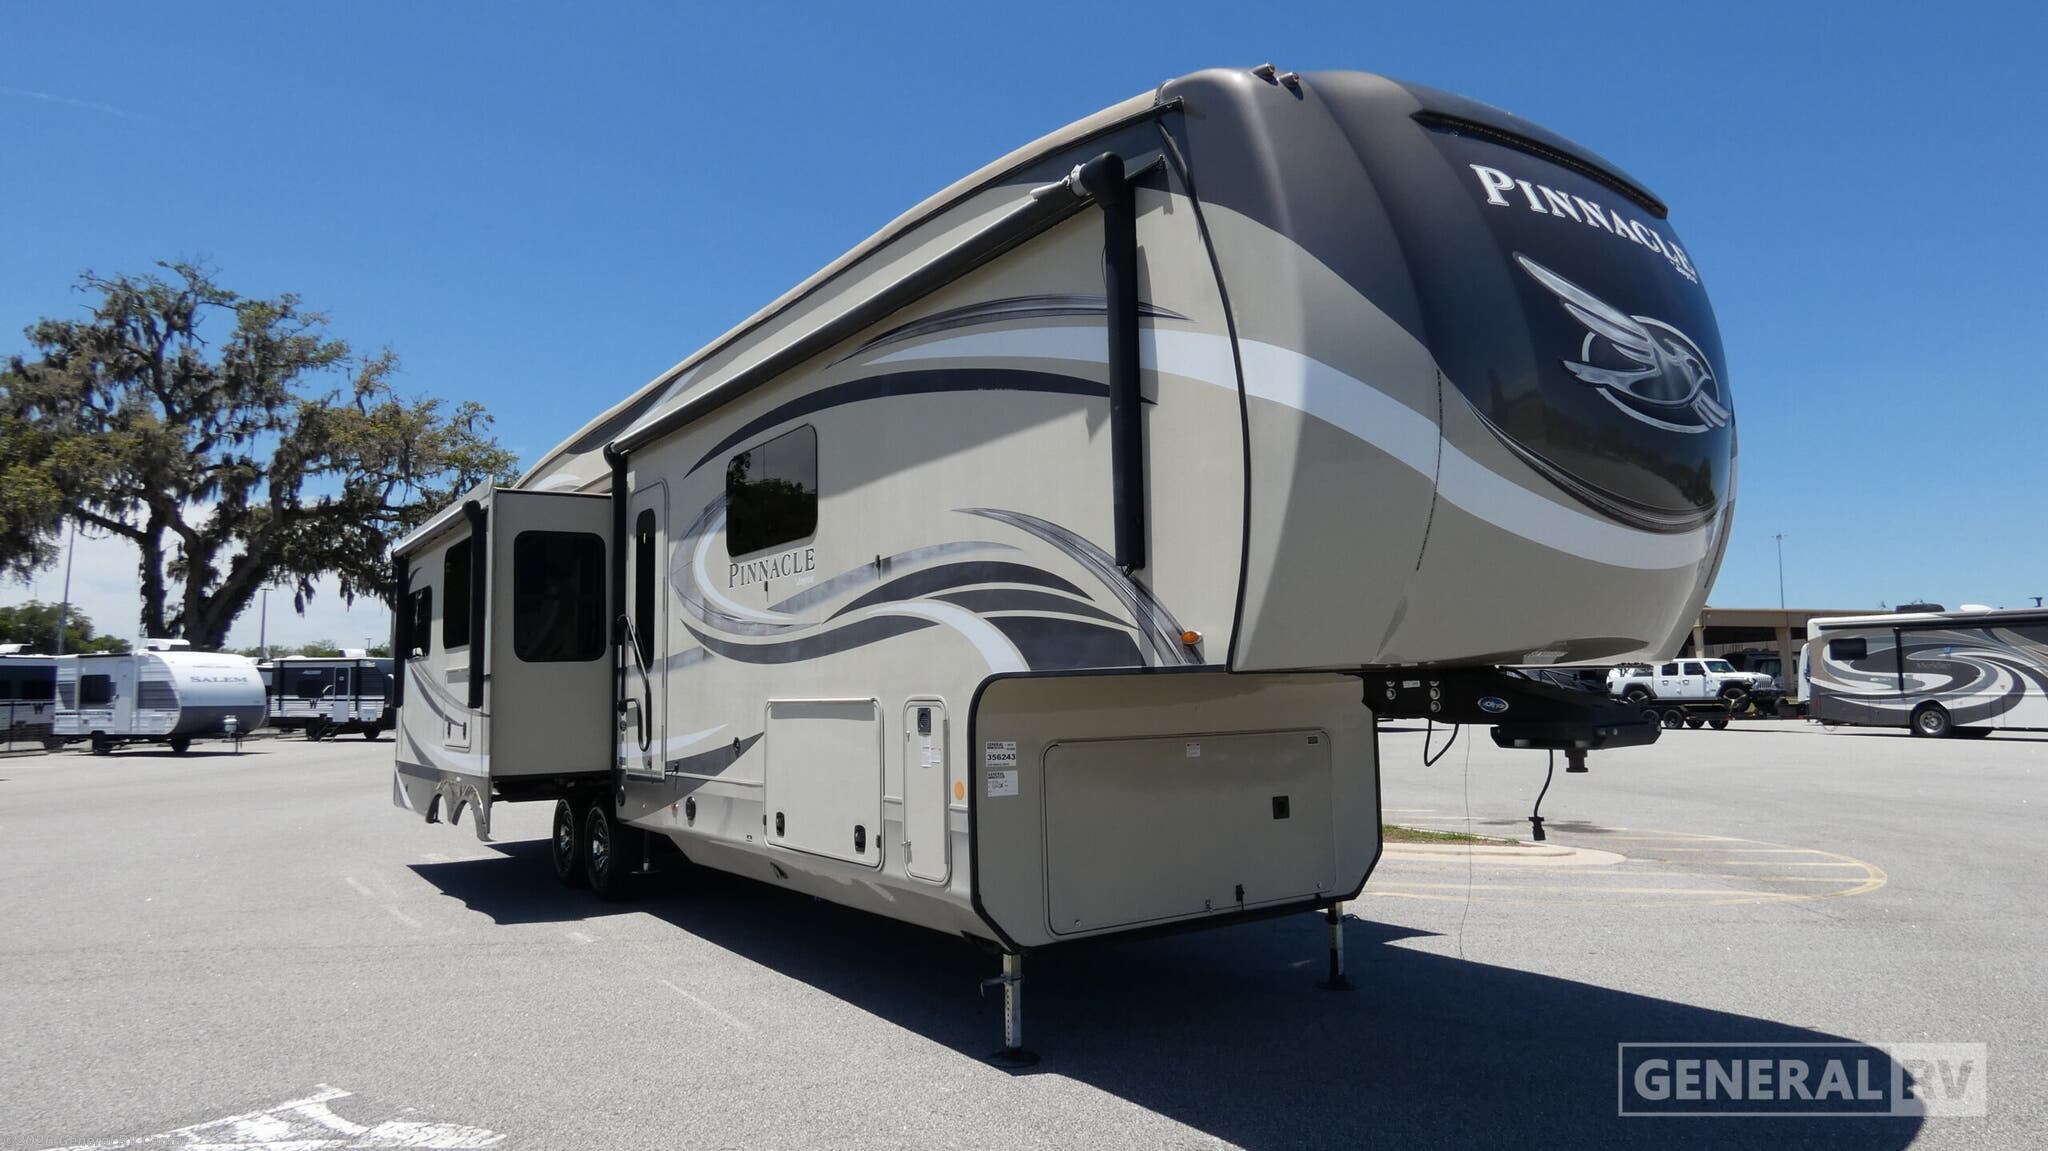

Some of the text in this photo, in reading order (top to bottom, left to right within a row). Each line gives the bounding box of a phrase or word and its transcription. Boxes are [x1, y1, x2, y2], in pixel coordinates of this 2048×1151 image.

[1469, 163, 1697, 278] PINNACLE
[729, 548, 815, 588] PINNACLE
[986, 753, 1016, 761] 356243
